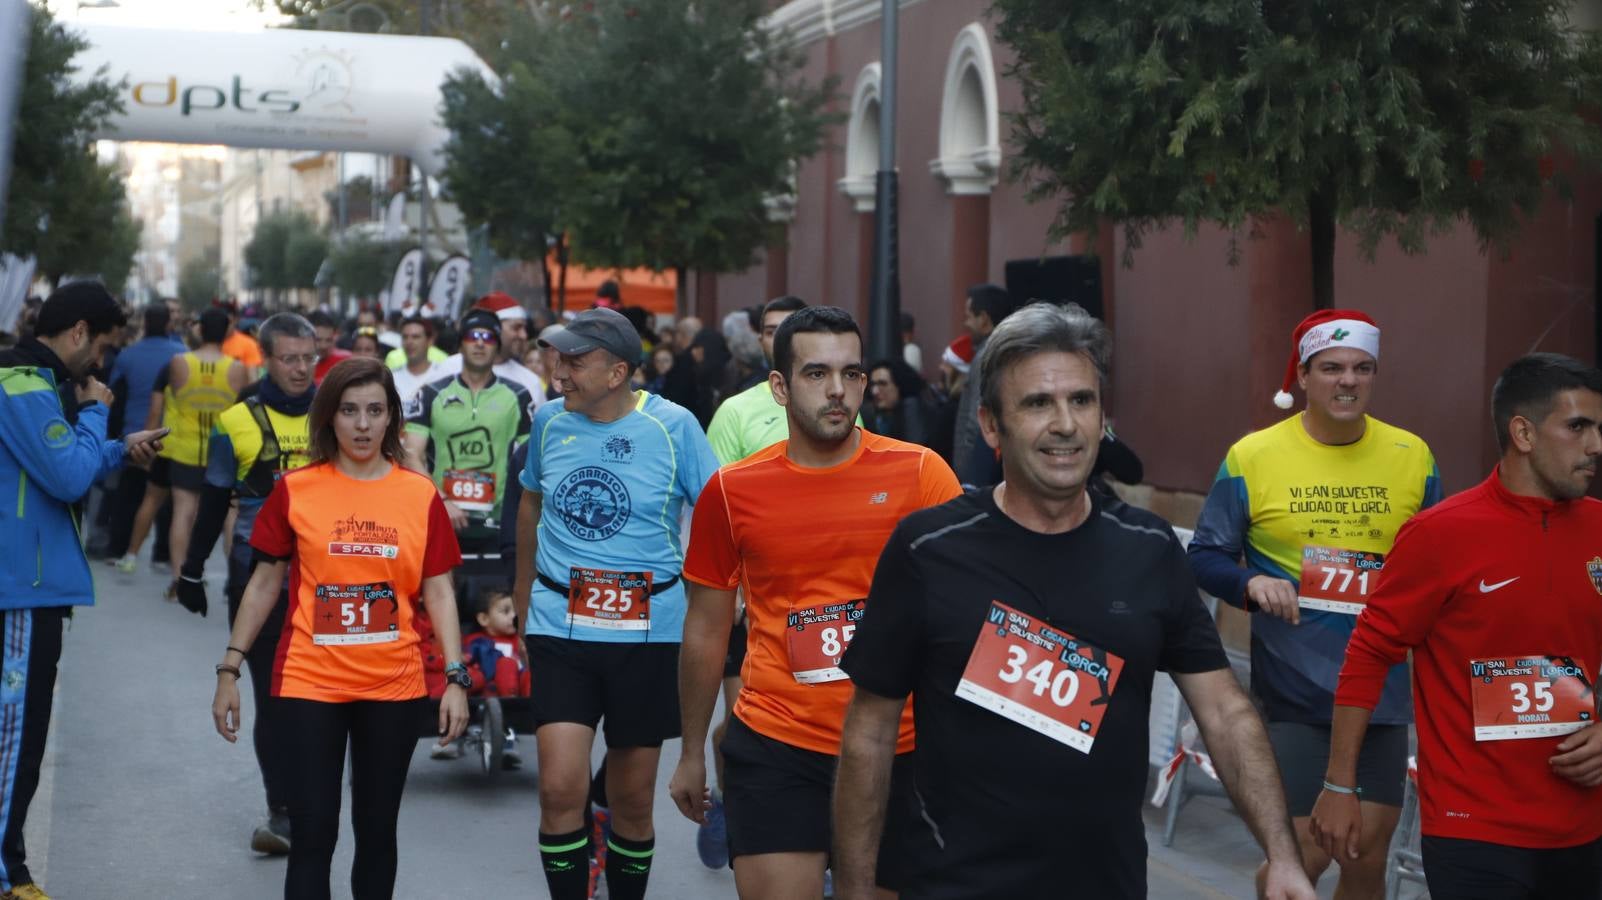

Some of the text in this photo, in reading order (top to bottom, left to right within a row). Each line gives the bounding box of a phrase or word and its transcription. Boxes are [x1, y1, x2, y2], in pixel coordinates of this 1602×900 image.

[132, 74, 300, 116] dpts
[460, 441, 484, 456] KD
[452, 480, 485, 499] 695
[568, 469, 627, 503] CARRASCA
[1290, 485, 1389, 500] VI SAN SILVESTRE
[1290, 501, 1391, 515] CIUDAD DE LORCA
[355, 520, 376, 533] VIII
[342, 544, 382, 555] SPAR
[1321, 566, 1369, 595] 771
[364, 590, 393, 600] LORCA
[586, 587, 632, 612] 225
[341, 602, 369, 626] 51
[800, 609, 815, 617] SAN
[825, 605, 847, 613] CIUDAD
[990, 607, 1005, 624] VI
[789, 615, 798, 626] VI
[803, 613, 840, 624] SILVESTRE
[1008, 612, 1029, 628] SAN
[1009, 623, 1056, 651] SILVESTRE
[1040, 628, 1079, 650] CIUDAD DE
[1061, 650, 1109, 681] LORCA
[1472, 663, 1485, 676] VI
[1487, 661, 1505, 669] SAN
[1492, 667, 1533, 676] SILVESTRE
[1541, 666, 1583, 678] LORCA
[998, 644, 1080, 707] 340
[1510, 681, 1554, 713] 35
[1518, 713, 1551, 723] MORATA
